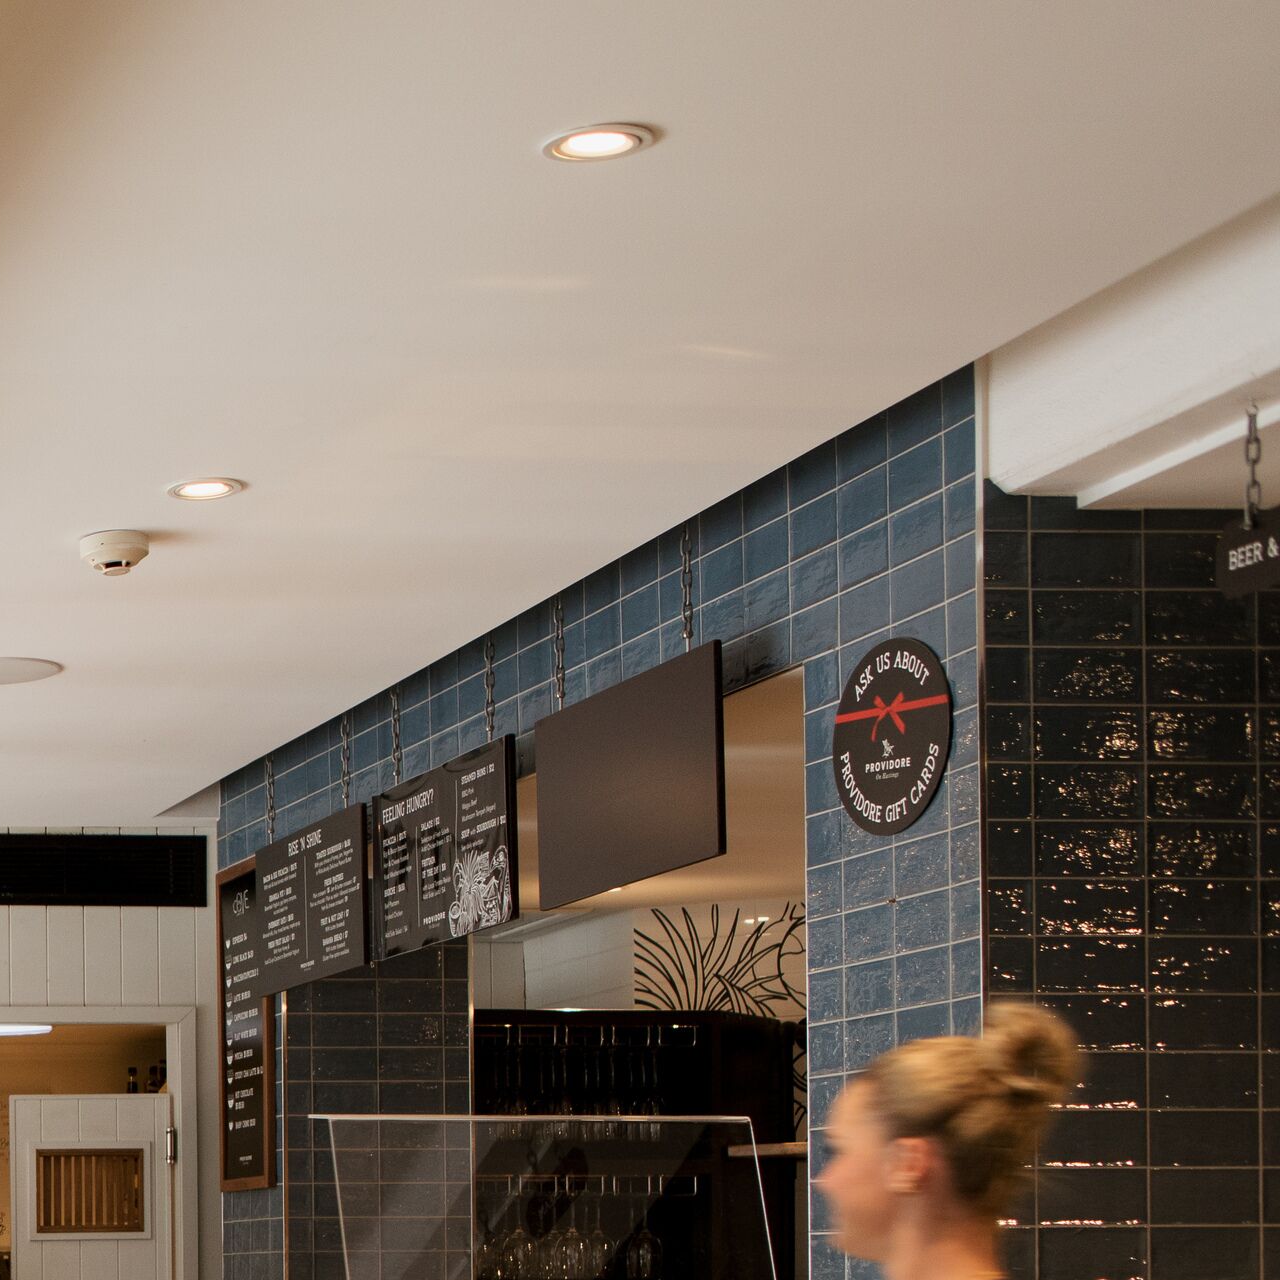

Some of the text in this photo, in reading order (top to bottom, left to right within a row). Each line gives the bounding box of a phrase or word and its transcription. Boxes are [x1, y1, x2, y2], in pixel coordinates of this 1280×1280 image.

[1228, 536, 1279, 571] BEER &
[854, 650, 930, 702] ASK US ABOUT
[461, 771, 476, 785] STEAMED
[476, 768, 486, 779] BUNS
[865, 757, 911, 774] PROVIDORE
[840, 742, 939, 823] PROVIDORE GIFT CARDS
[382, 788, 434, 825] FEELING HUNGRY?
[421, 819, 433, 831] SALADS
[461, 828, 470, 839] SOUP
[476, 818, 497, 833] SOURDOUGH
[288, 840, 299, 857] RISE
[306, 829, 322, 848] SHINE
[423, 911, 446, 926] PROVIDORE
